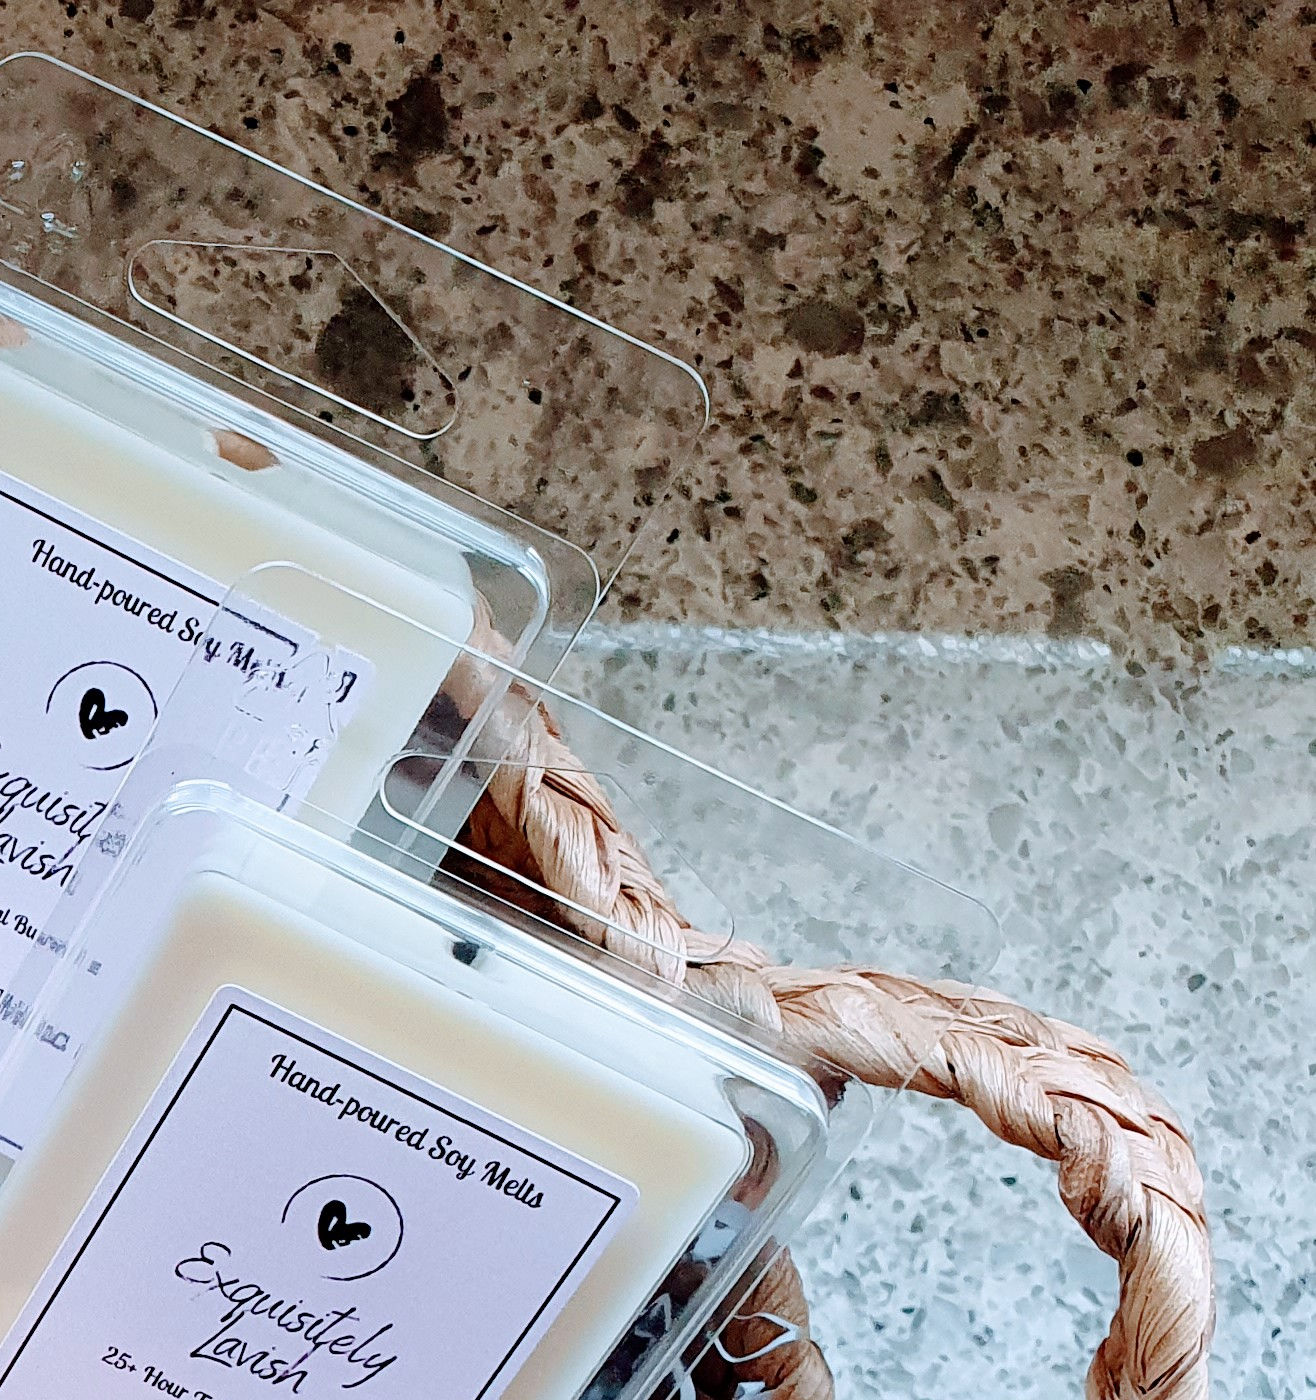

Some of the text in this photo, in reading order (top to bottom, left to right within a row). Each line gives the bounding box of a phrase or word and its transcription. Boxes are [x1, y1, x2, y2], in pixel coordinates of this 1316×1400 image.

[31, 539, 176, 632] Hand-poured
[268, 1053, 545, 1209] Hand-poured Soy Melts
[174, 1241, 398, 1389] Exquisitely
[190, 1315, 308, 1393] Lavish
[101, 1346, 138, 1374] 25+
[143, 1363, 189, 1400] Hour
